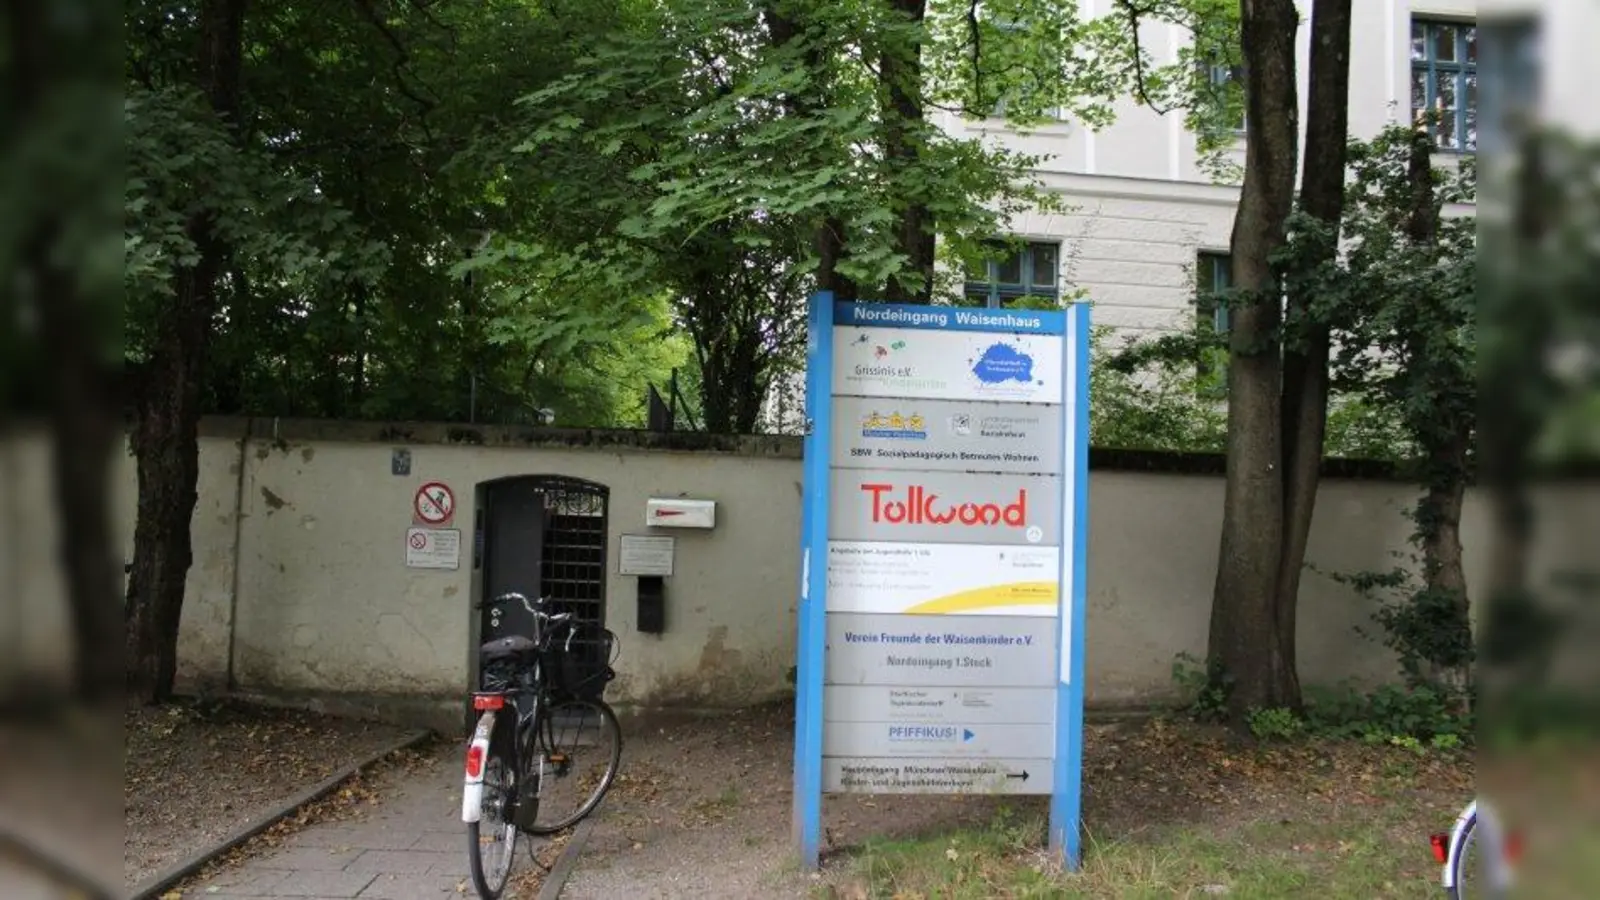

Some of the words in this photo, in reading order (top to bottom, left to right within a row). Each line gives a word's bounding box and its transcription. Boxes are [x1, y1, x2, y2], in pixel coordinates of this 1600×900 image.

[854, 307, 947, 326] Nordeingang
[955, 311, 1041, 328] Waisenhaus
[855, 364, 895, 376] Grissinis
[850, 448, 872, 457] SBW
[960, 452, 1001, 460] Betreutes
[1002, 453, 1039, 462] Wohnen
[861, 484, 1026, 526] Tollwood
[845, 631, 878, 643] Verein
[881, 633, 921, 644] Freunde
[925, 634, 940, 644] der
[943, 634, 1014, 645] Waisenkinder
[1016, 635, 1033, 646] e.V.
[886, 655, 953, 670] Nordeingang
[889, 726, 957, 739] PFIFFIKUS!
